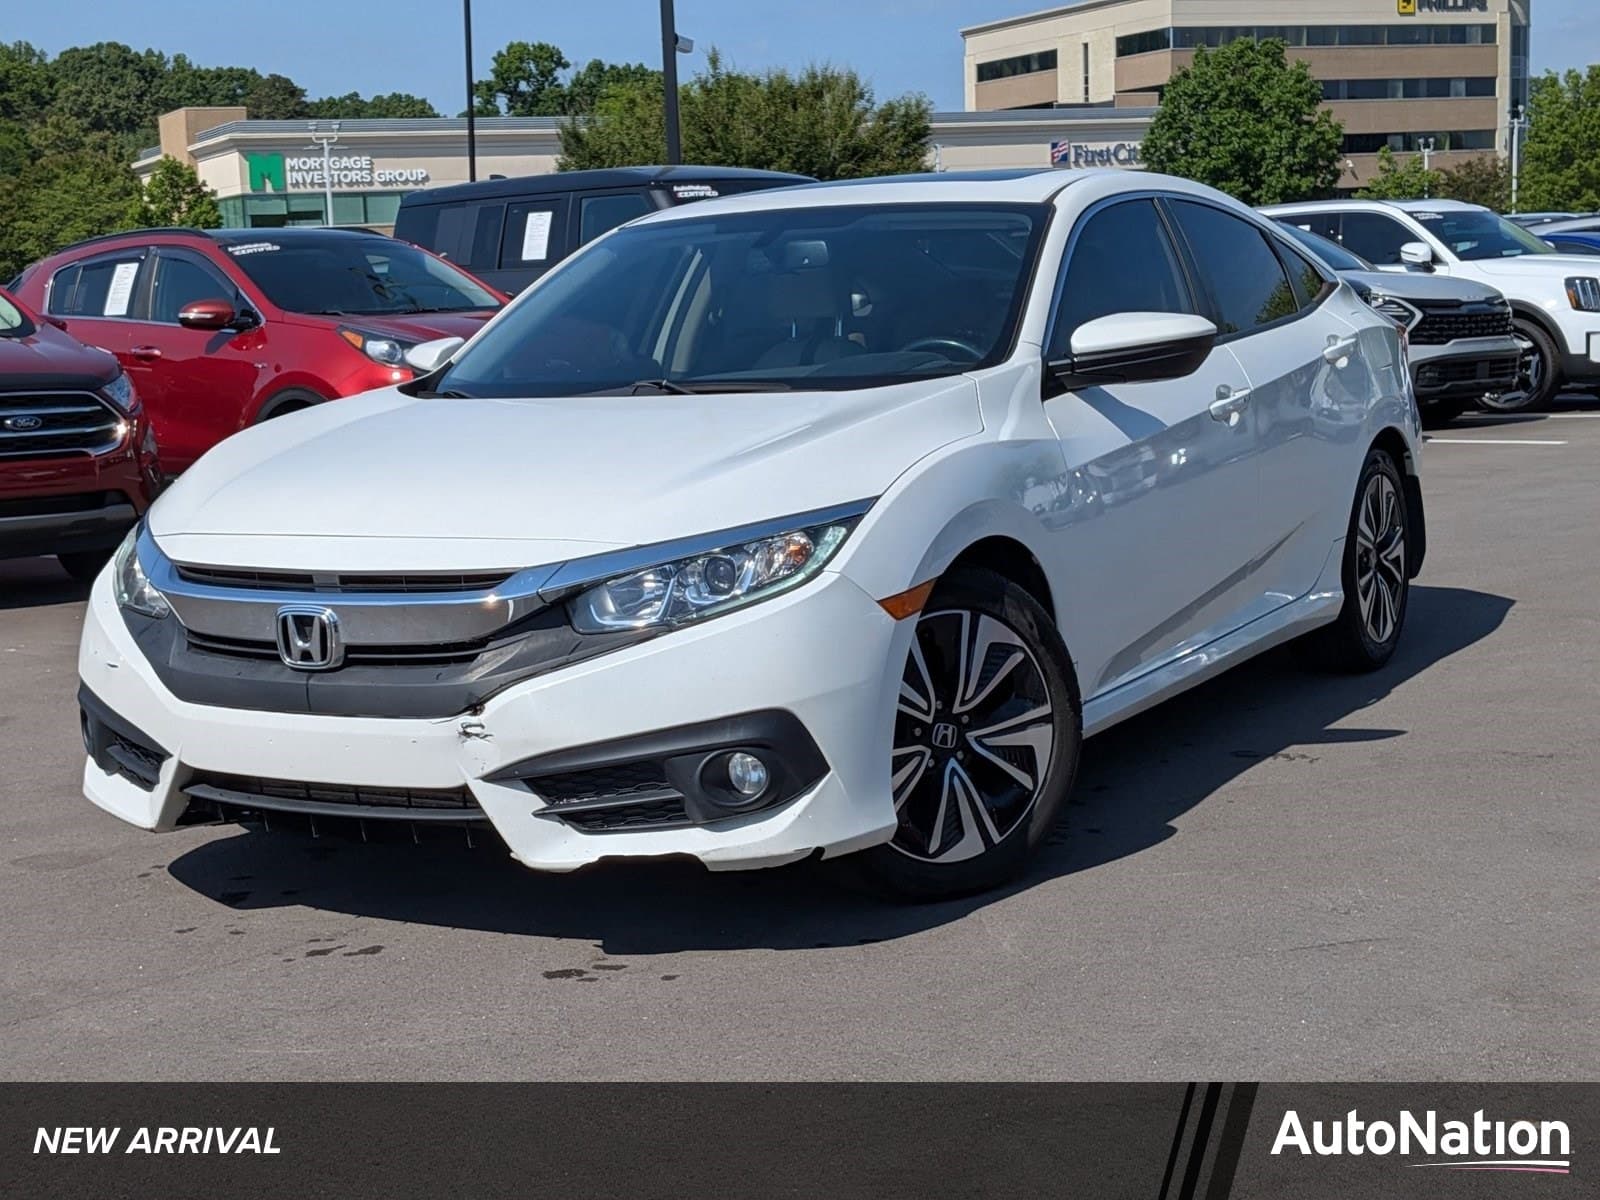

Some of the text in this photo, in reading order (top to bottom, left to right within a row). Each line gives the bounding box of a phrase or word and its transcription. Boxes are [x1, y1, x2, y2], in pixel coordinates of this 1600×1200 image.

[286, 156, 371, 170] MORTGAGE
[287, 168, 428, 184] INVESTORS GROUP
